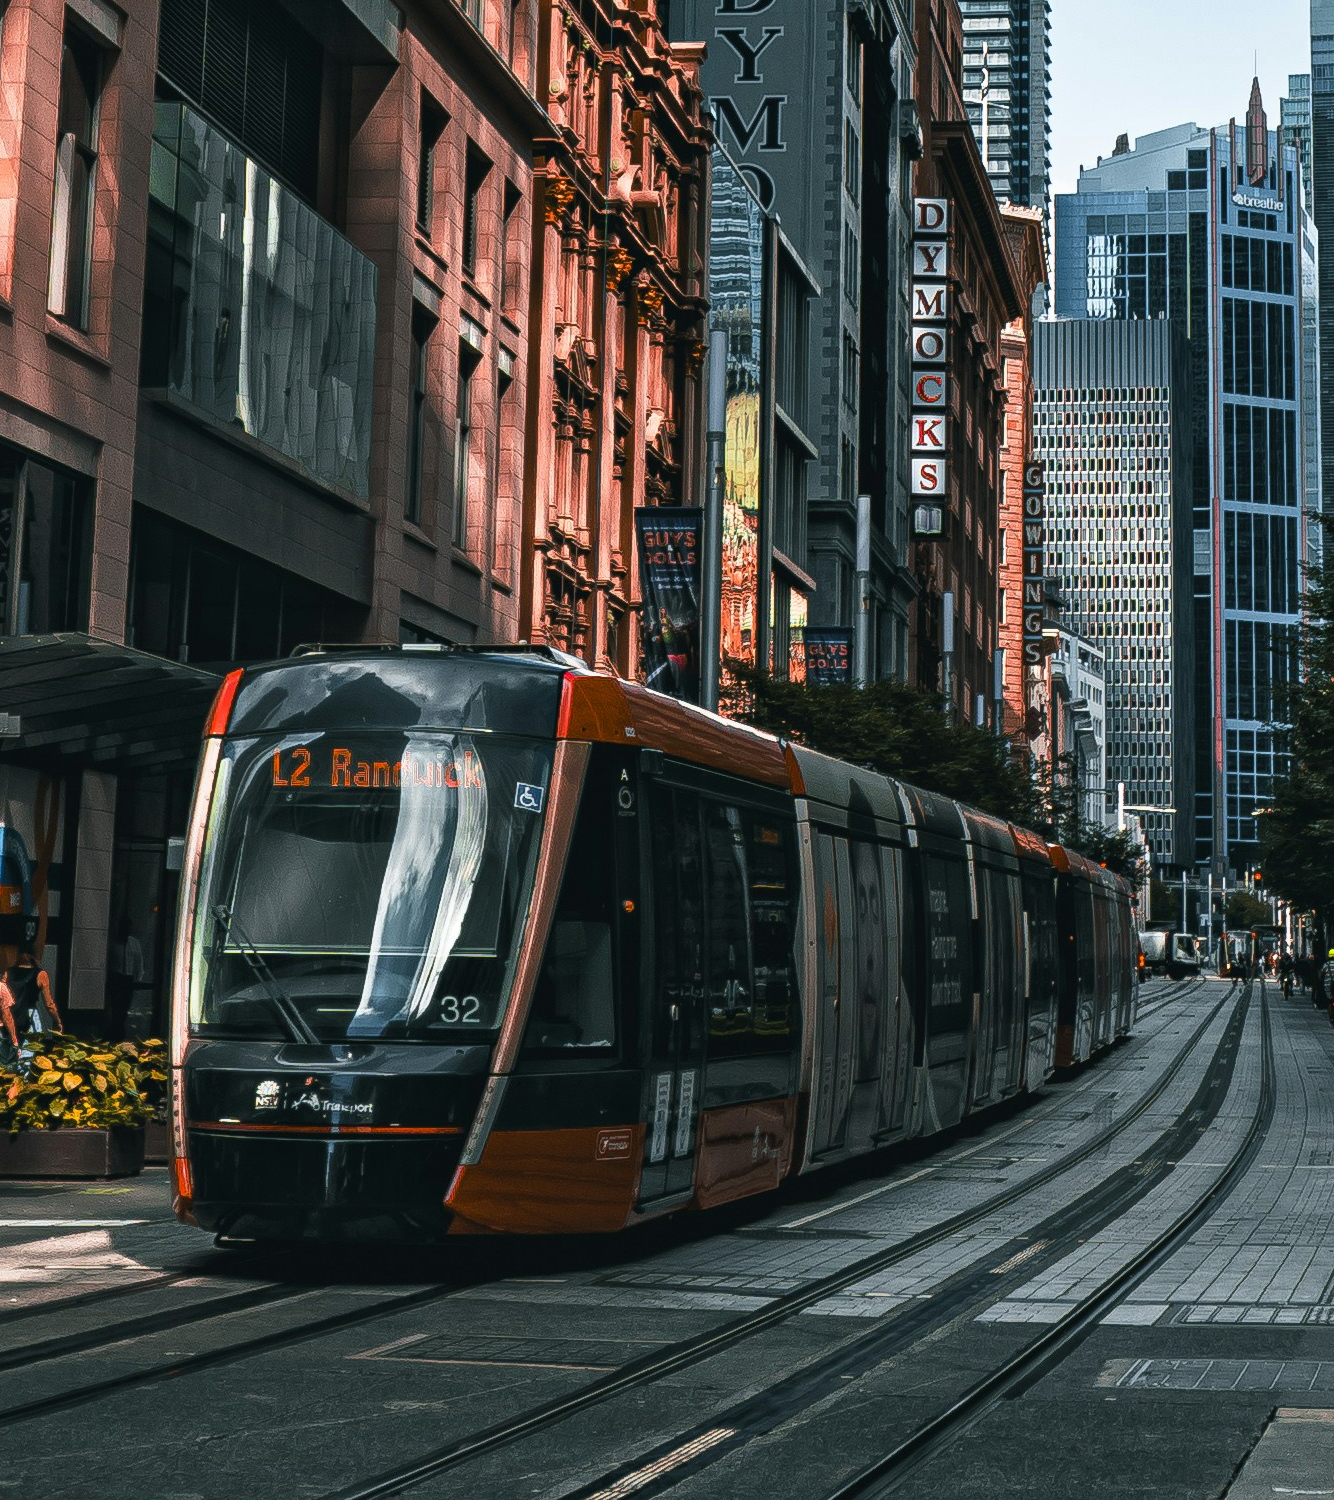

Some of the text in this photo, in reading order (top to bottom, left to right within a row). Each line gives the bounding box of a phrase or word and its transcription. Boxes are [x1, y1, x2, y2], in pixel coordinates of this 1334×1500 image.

[1243, 194, 1285, 212] breathe
[915, 202, 945, 491] DYMOCKS
[643, 531, 696, 548] GUYS
[1025, 464, 1042, 665] GOWINGS
[273, 748, 482, 788] L2 Randwick
[621, 769, 628, 781] A
[441, 996, 480, 1023] 32
[255, 1097, 278, 1107] NSW
